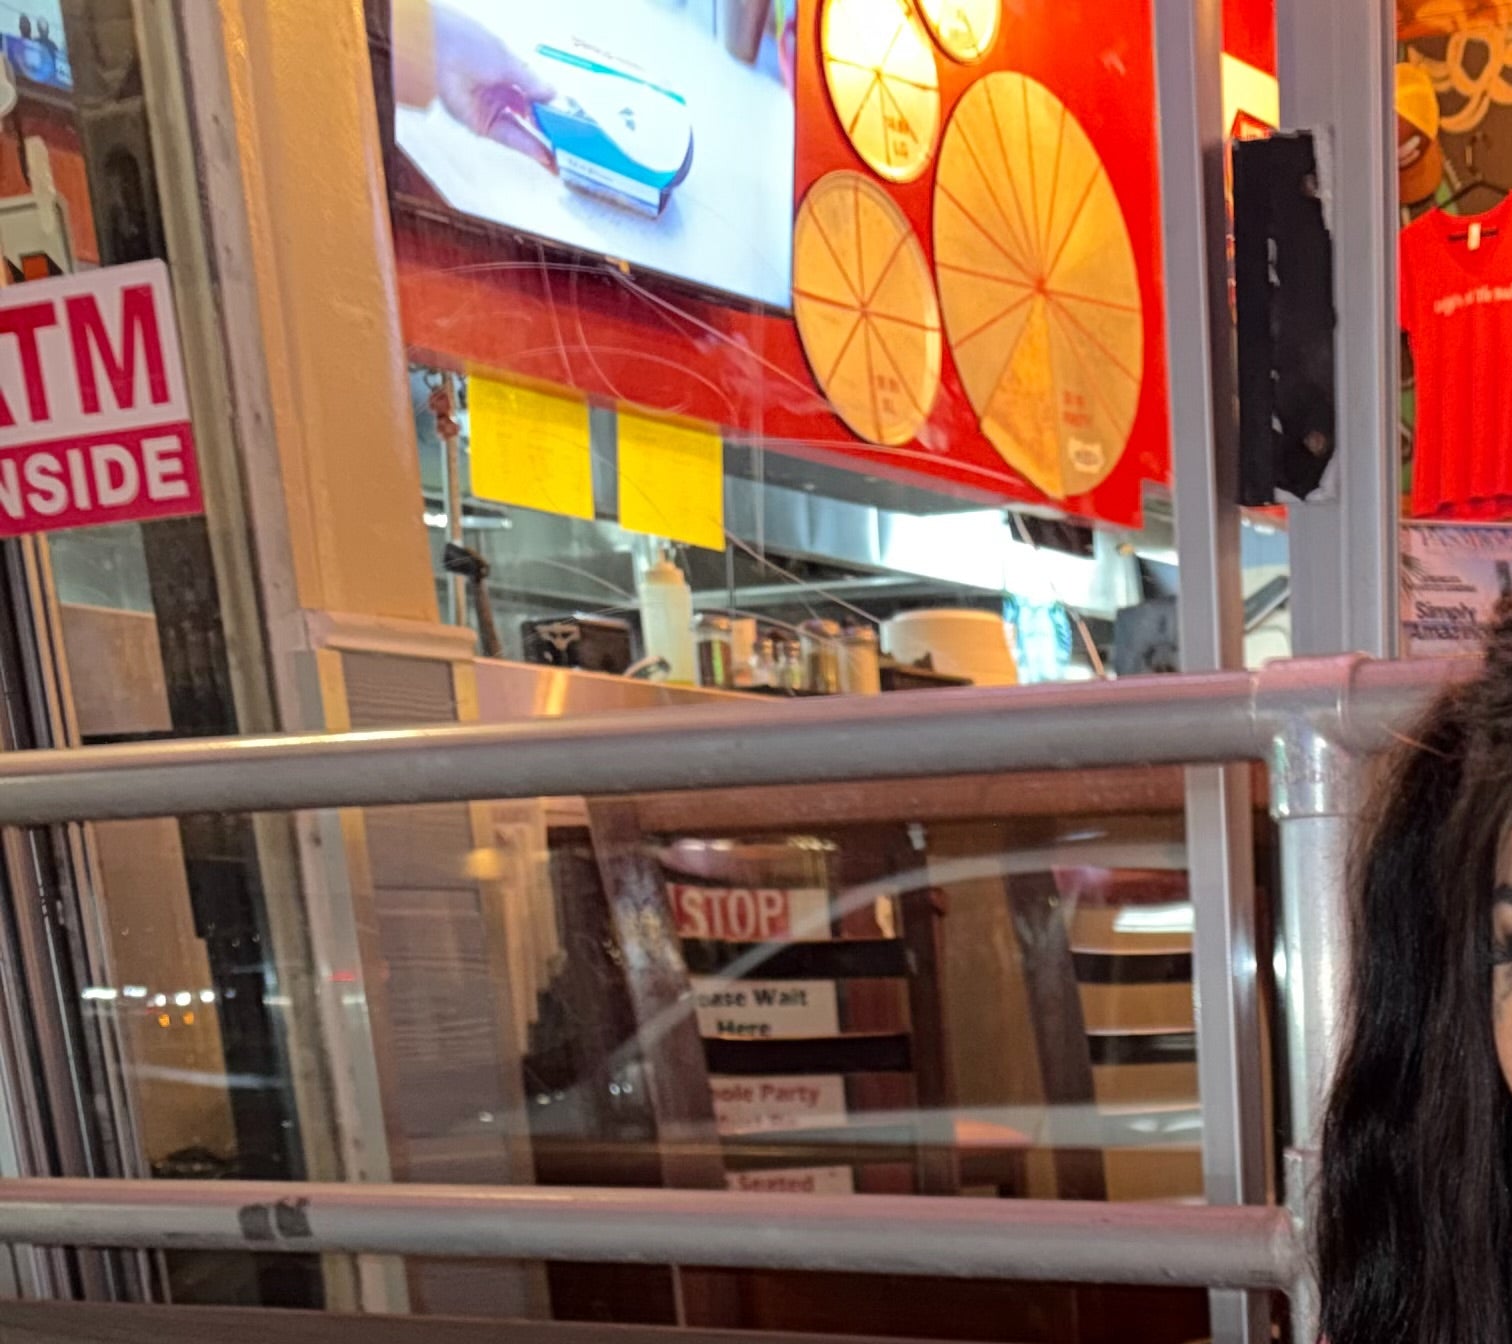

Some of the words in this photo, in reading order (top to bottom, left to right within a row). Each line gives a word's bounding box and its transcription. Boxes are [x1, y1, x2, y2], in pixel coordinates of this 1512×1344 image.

[0, 283, 170, 428] TM
[680, 889, 785, 939] STOP
[752, 988, 808, 1007] Wait
[716, 1020, 772, 1037] Here
[761, 1083, 819, 1108] Party
